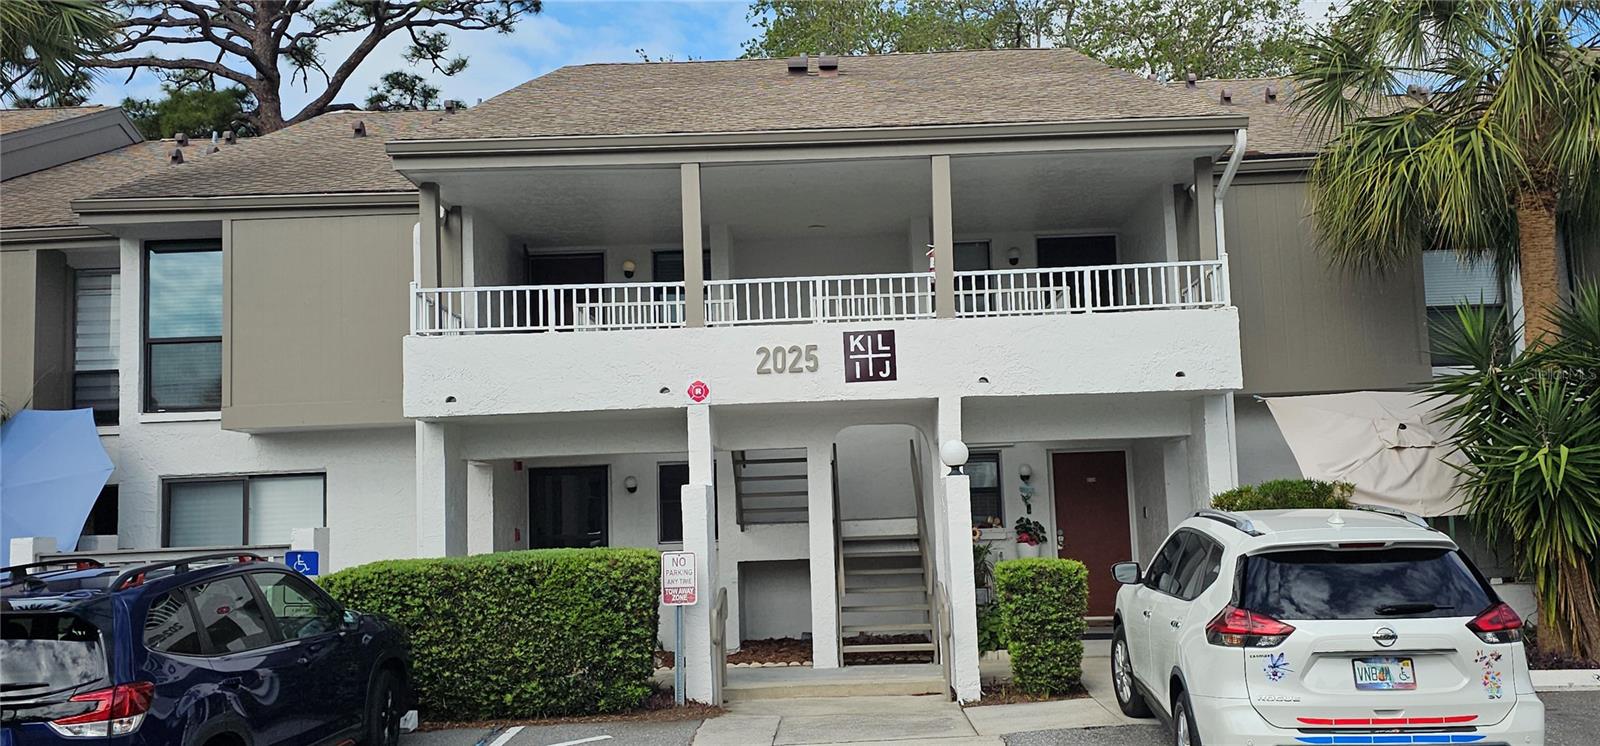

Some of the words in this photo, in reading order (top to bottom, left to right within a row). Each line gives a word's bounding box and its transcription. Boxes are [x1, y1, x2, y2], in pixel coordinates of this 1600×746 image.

[849, 334, 865, 352] K
[877, 333, 891, 351] L
[755, 344, 819, 375] 2025
[855, 361, 862, 379] I
[878, 360, 891, 378] J
[672, 557, 687, 567] NO
[679, 587, 694, 595] AWAY
